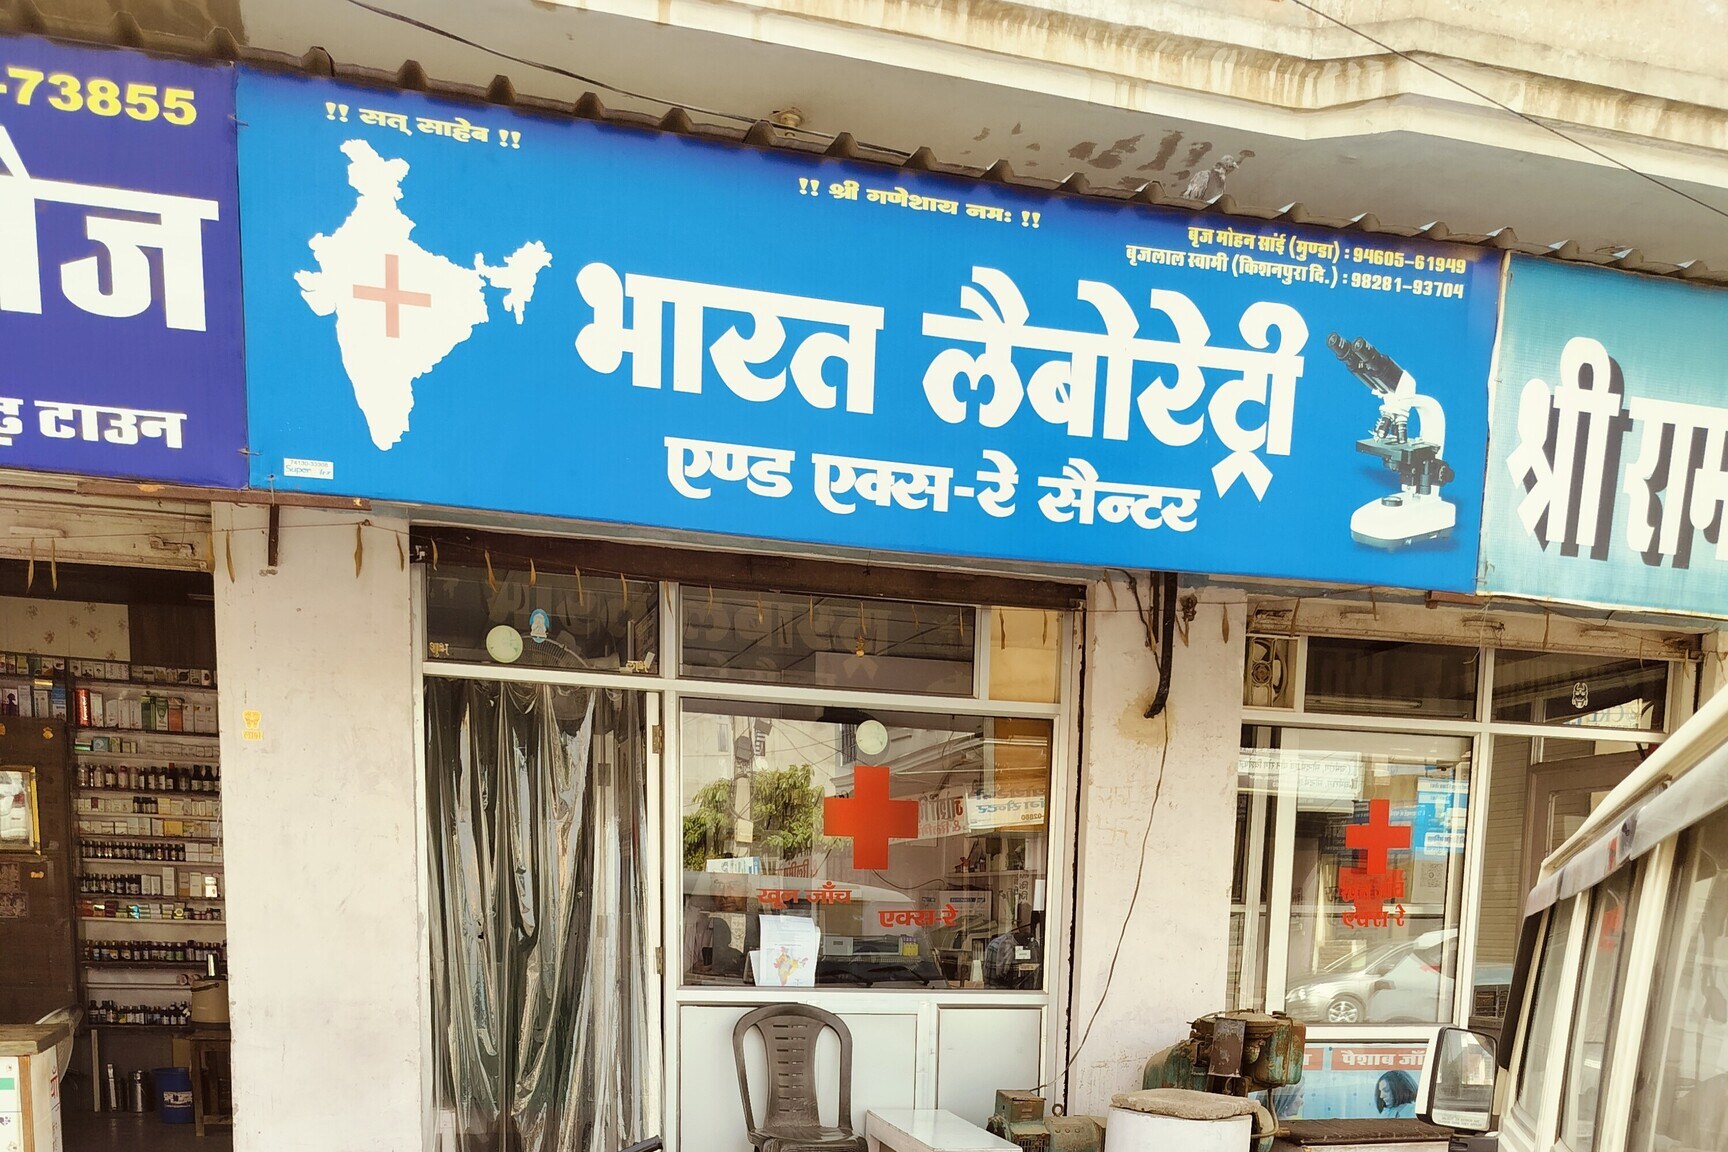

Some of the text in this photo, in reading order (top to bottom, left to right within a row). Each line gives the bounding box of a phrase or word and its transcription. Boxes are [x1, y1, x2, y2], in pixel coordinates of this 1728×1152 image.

[358, 108, 413, 137] सत्
[828, 180, 860, 201] श्री
[865, 186, 960, 215] गणेशाय
[965, 203, 1012, 224] नमः
[1125, 244, 1187, 267] बृजलाल
[1187, 252, 1229, 272] स्वामी
[1351, 272, 1464, 299] 98281-93704
[1187, 226, 1215, 248] बृज
[1216, 227, 1256, 250] मोहन
[1353, 247, 1467, 274] 94605-61949
[574, 261, 1310, 502] भारत लैबोरेट्री
[34, 399, 187, 449] टाउन
[1505, 337, 1624, 558] श्री
[664, 435, 1201, 532] एण्ड एक्स-रे सैन्टर
[756, 880, 852, 909] खून जाँच
[878, 903, 959, 928] एक्स-रे
